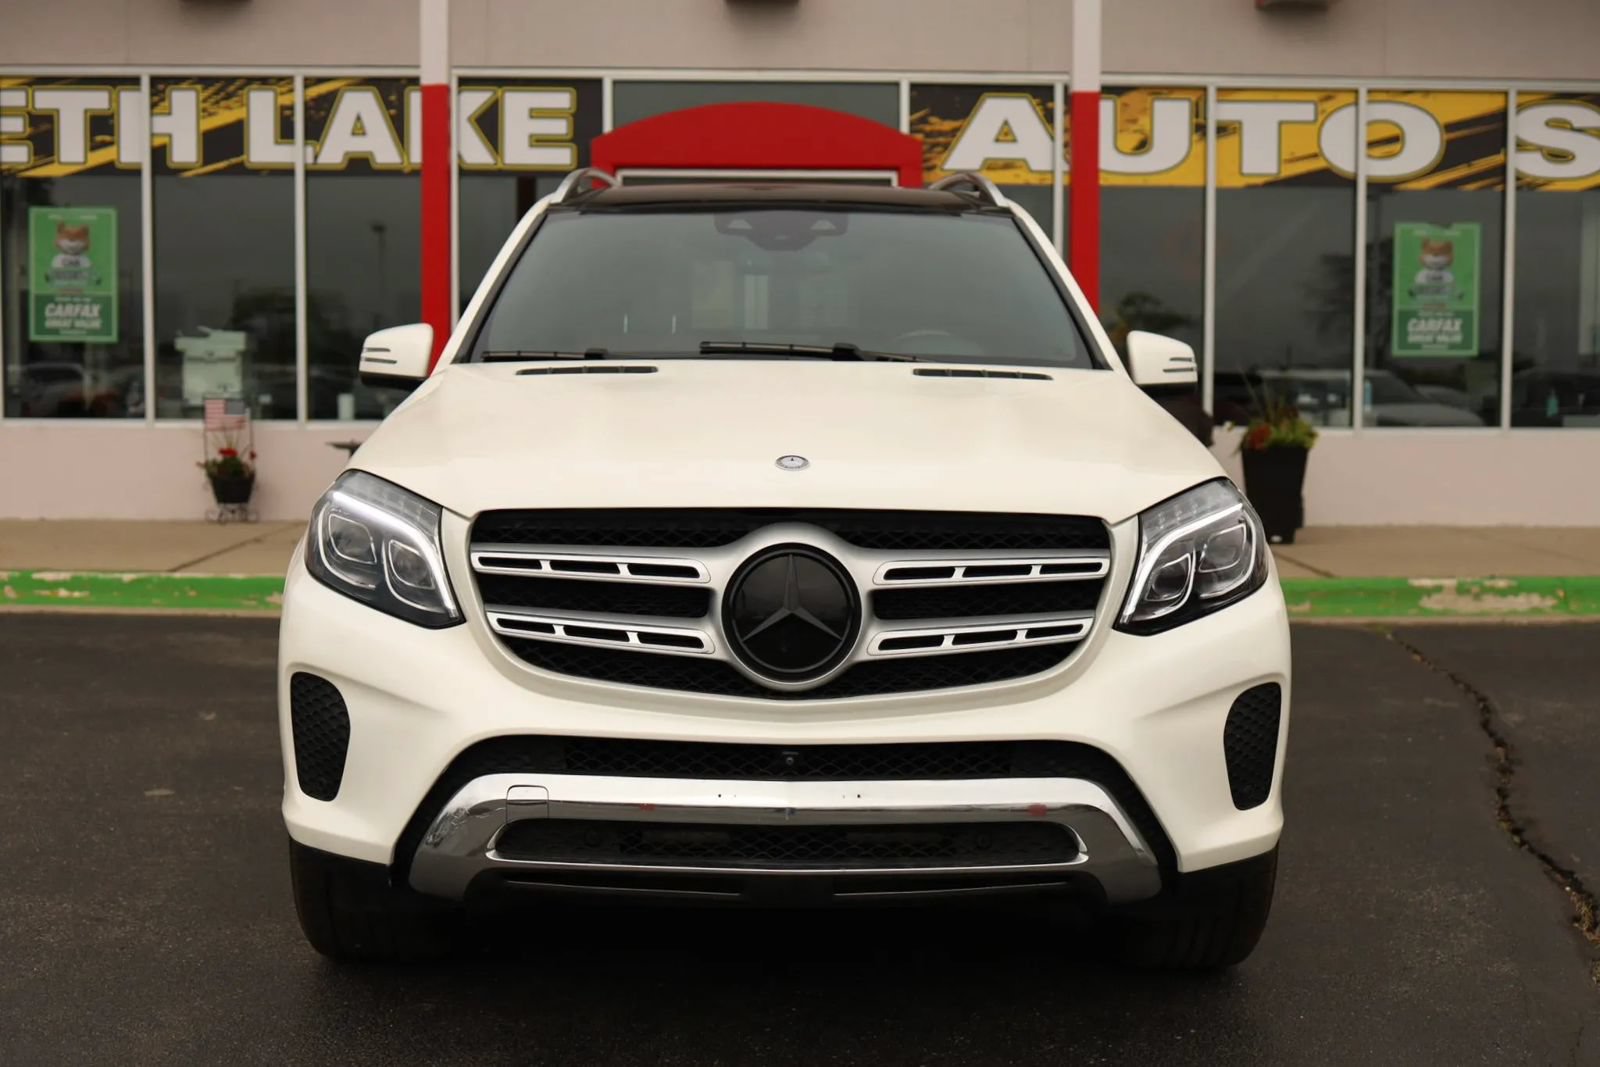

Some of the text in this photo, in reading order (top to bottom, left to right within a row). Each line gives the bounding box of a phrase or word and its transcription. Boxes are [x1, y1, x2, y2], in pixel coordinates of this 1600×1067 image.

[243, 86, 578, 171] LAKE
[938, 92, 1446, 183] AUTO
[45, 303, 102, 318] CARFAX
